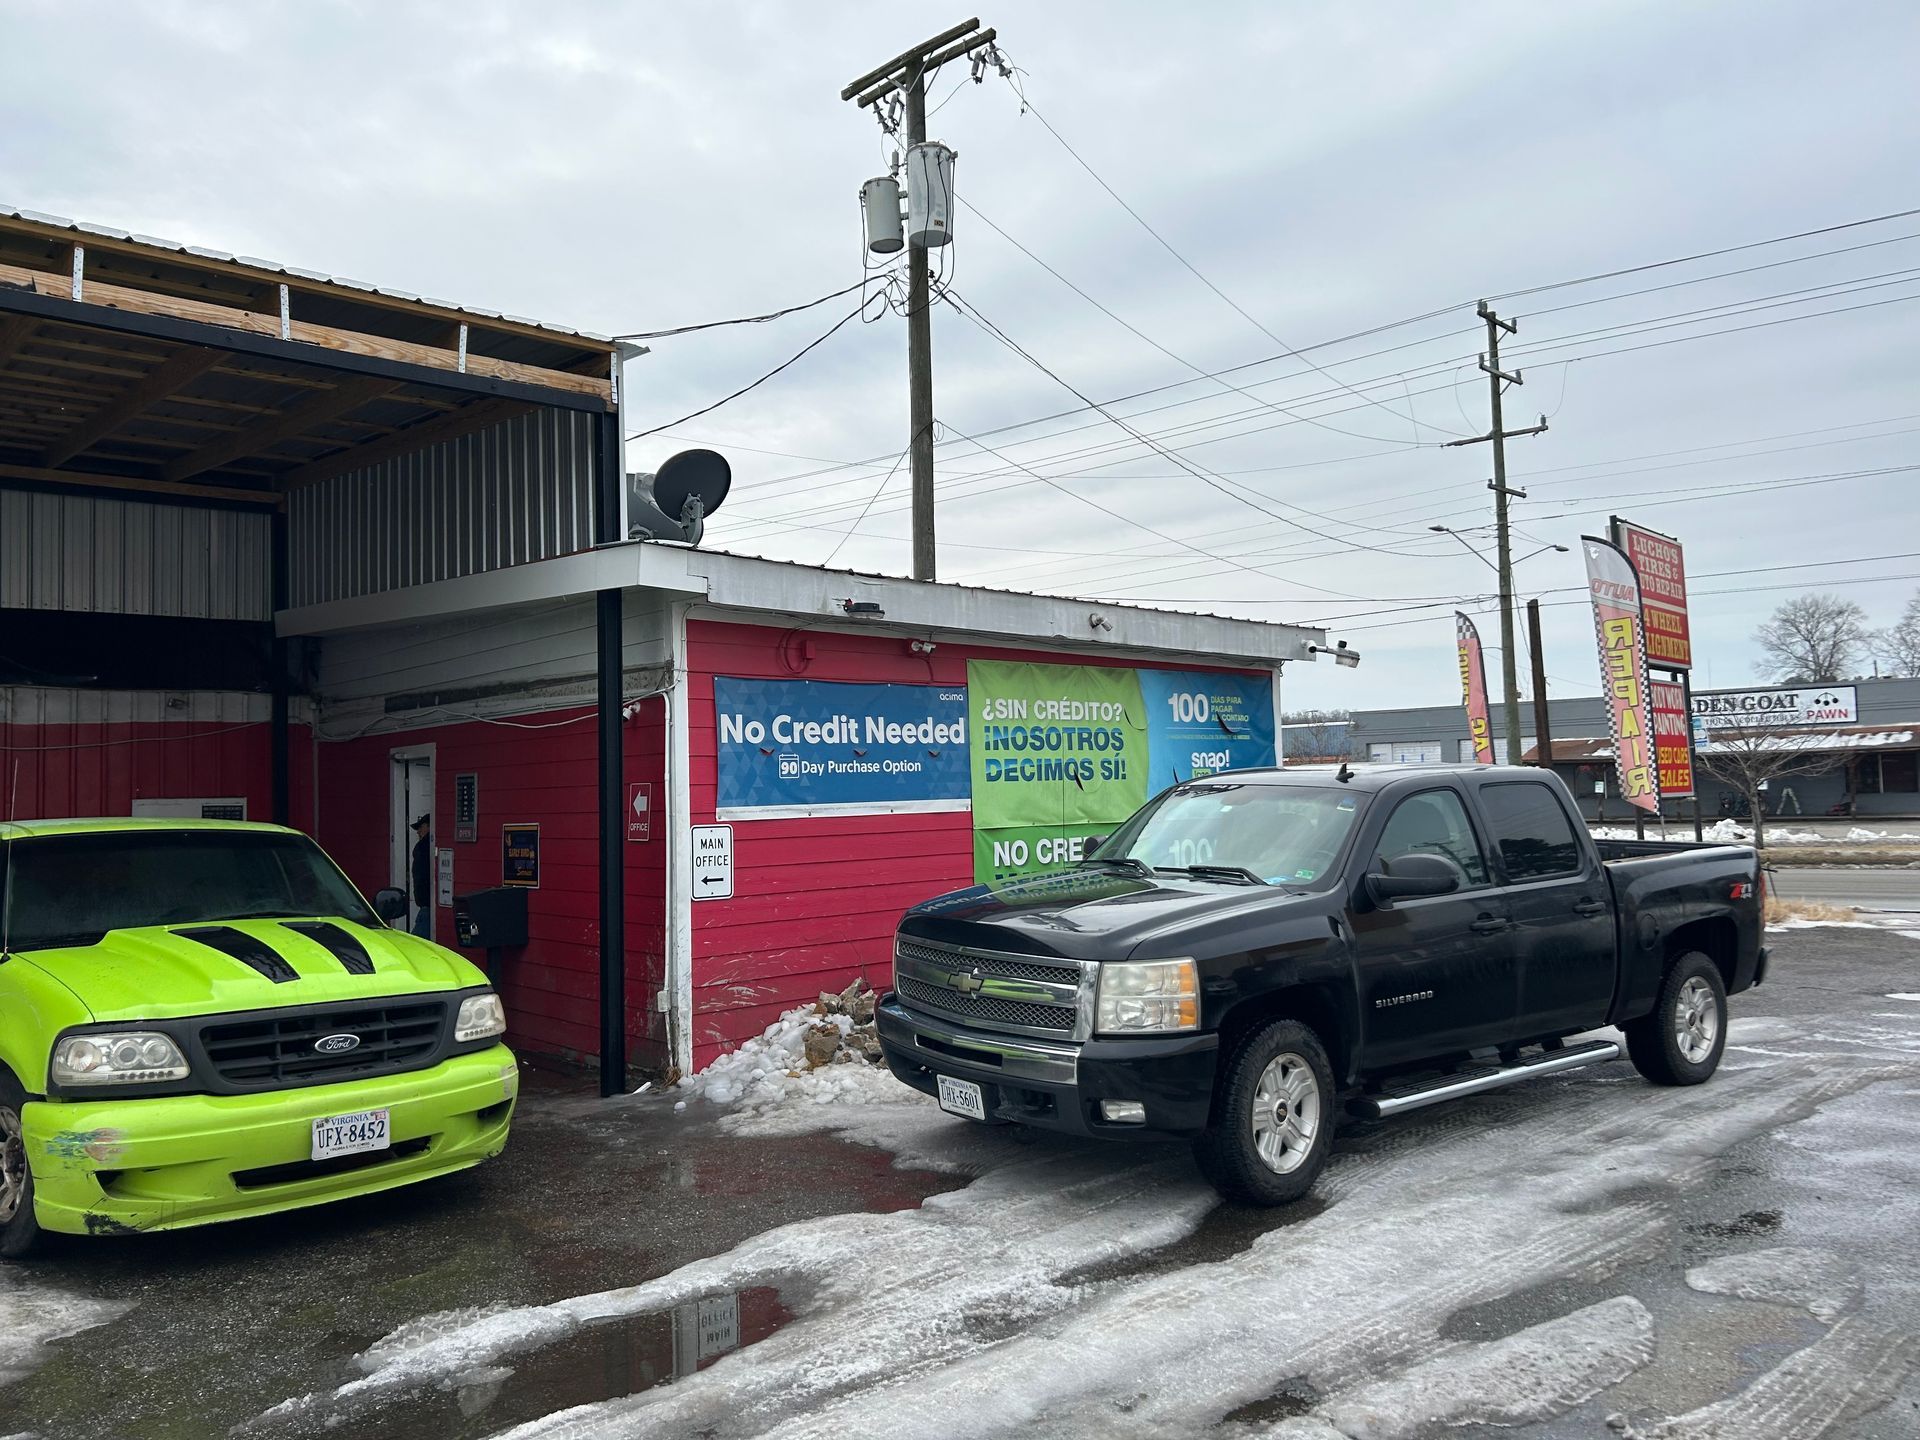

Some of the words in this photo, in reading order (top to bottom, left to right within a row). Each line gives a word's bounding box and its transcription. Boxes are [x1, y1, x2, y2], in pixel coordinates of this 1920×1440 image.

[1637, 554, 1672, 579] TIRES
[1672, 568, 1679, 580] &
[1639, 573, 1655, 593] UTO
[1655, 577, 1684, 600] REPAIR
[1643, 608, 1651, 627] 4
[1651, 611, 1683, 634] WHEEL
[1646, 635, 1690, 661] LIGNMENT
[939, 692, 964, 701] acima
[1168, 693, 1209, 723] 100
[1226, 696, 1242, 705] PARA
[1666, 687, 1684, 710] WORK
[1690, 698, 1736, 714] DEN
[1741, 694, 1799, 711] GOAT
[982, 699, 1027, 721] ¿SIN
[1033, 696, 1123, 722] CRÉDITO?
[1211, 705, 1233, 713] PAGAR
[1806, 708, 1849, 721] PAWN
[720, 714, 766, 744] No
[772, 714, 859, 744] Credit
[866, 716, 965, 744] Needed
[1653, 712, 1687, 737] PAINTING
[984, 726, 1124, 751] ¡NOSOTROS
[781, 761, 798, 775] 90
[801, 761, 824, 776] Day
[828, 759, 880, 774] Purchase
[882, 759, 922, 776] Option
[985, 757, 1094, 782] DECIMOS
[1100, 753, 1127, 780] SÍ!
[1192, 749, 1230, 772] snap!
[1657, 747, 1673, 764] USED
[1673, 747, 1689, 765] CARS
[1659, 769, 1690, 787] SALES
[630, 823, 648, 832] OFFICE
[700, 838, 724, 849] MAIN
[993, 840, 1029, 867] NO
[1036, 837, 1088, 863] CRE
[695, 855, 729, 867] OFFICE
[1375, 990, 1433, 1008] SILVERADO
[326, 1037, 351, 1050] Ford
[331, 1113, 369, 1126] VIRGINIA
[317, 1120, 385, 1149] UFX-8452
